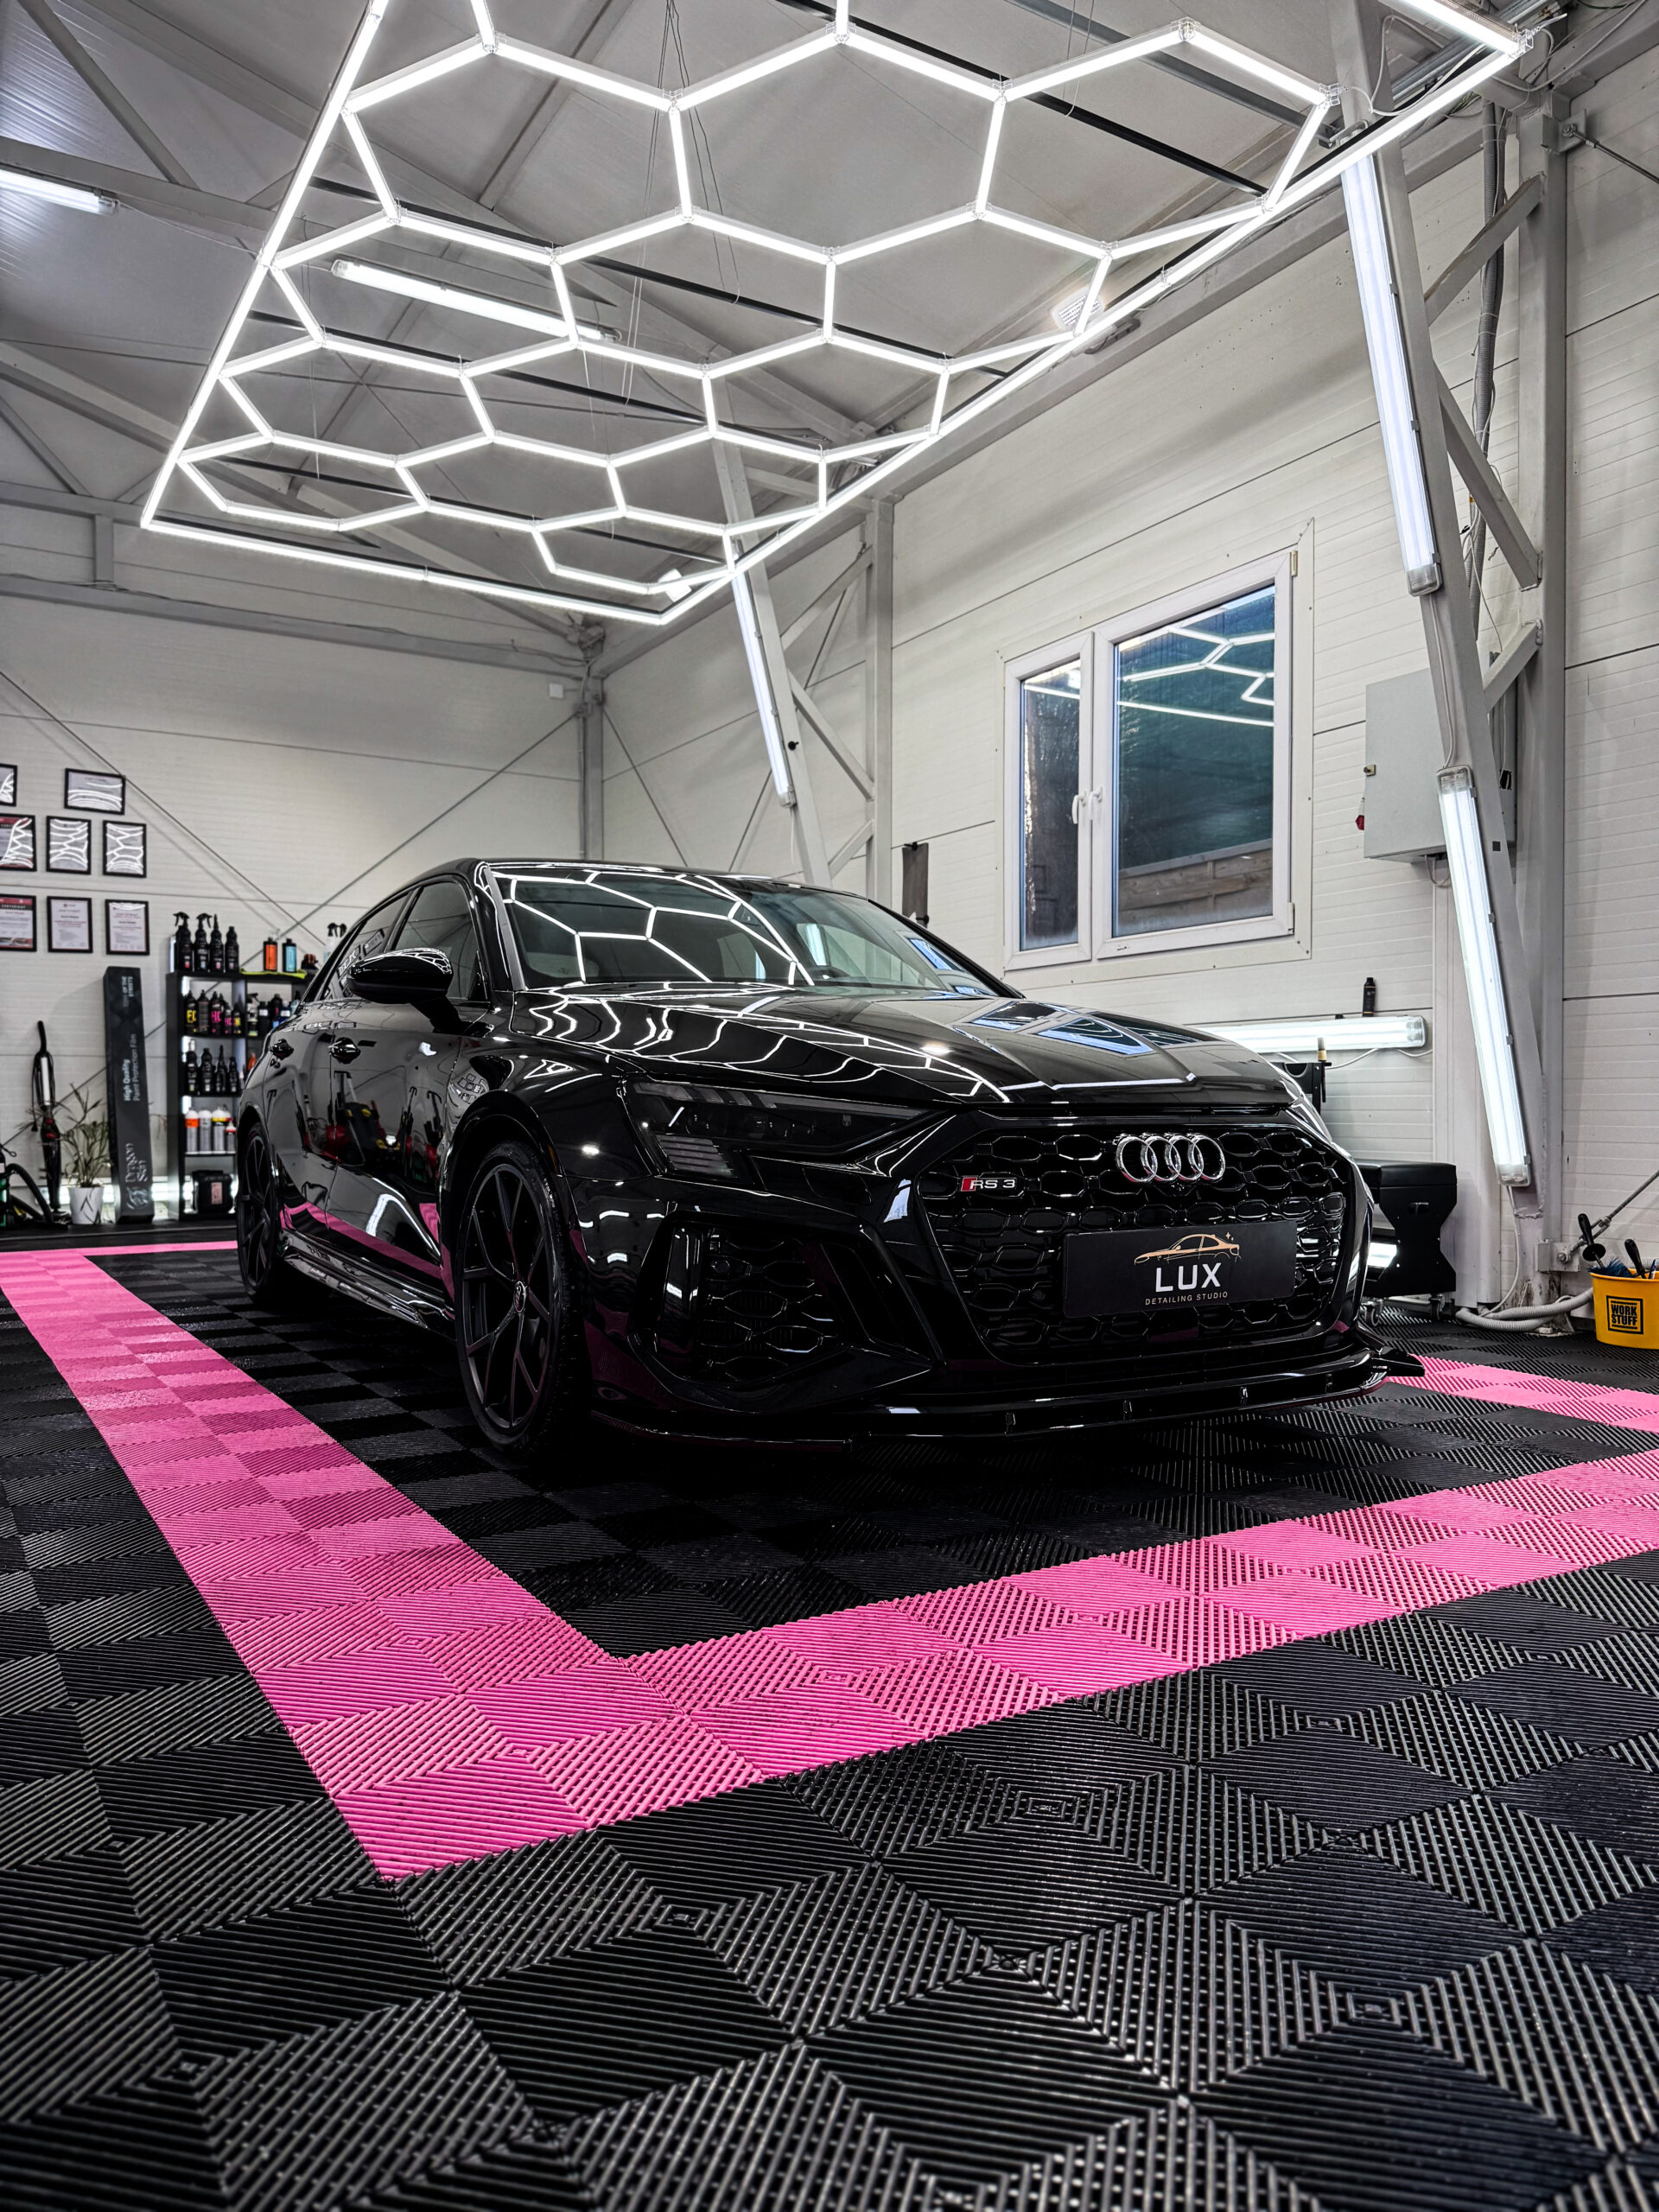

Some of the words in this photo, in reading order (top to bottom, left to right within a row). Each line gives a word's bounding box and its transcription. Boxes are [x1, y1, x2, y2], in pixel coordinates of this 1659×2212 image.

[122, 1058, 130, 1084] Quality
[124, 1085, 132, 1101] High
[1002, 1179, 1016, 1188] 3
[1155, 1262, 1222, 1292] LUX
[1145, 1294, 1192, 1306] DETAILING
[1196, 1291, 1228, 1300] STUDIO
[1611, 1304, 1637, 1315] WORK
[1611, 1313, 1638, 1325] STUFF
